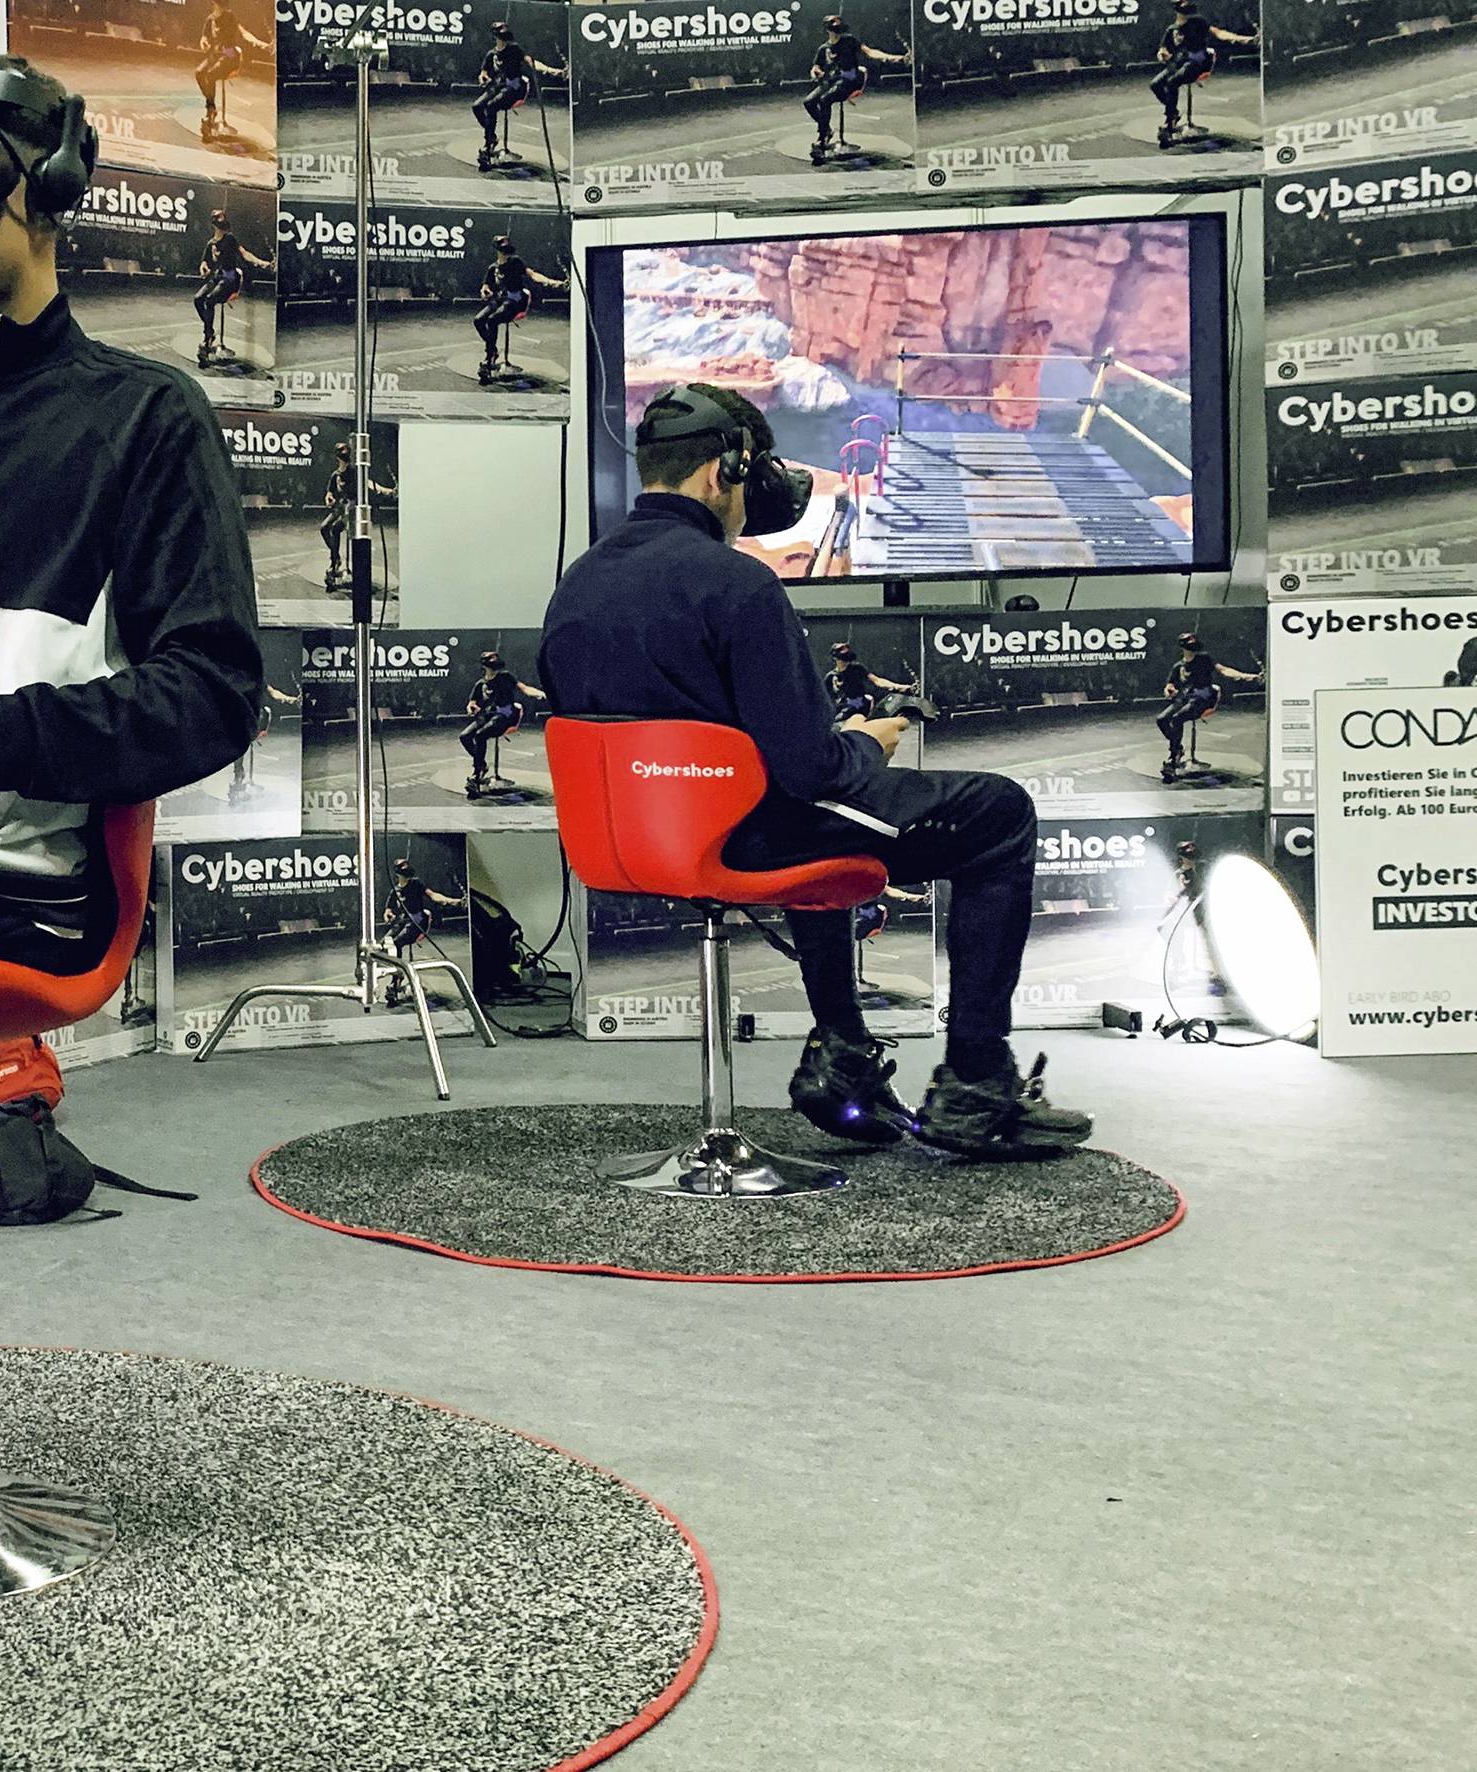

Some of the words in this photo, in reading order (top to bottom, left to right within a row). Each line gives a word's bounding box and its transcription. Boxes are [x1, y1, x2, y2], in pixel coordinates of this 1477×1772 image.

[581, 6, 791, 48] Cybershoes
[1276, 121, 1331, 145] STEP
[1337, 112, 1397, 137] INTO
[927, 148, 977, 167] STEP
[982, 145, 1035, 165] INTO
[1040, 143, 1069, 162] VR
[584, 164, 633, 184] STEP
[638, 162, 690, 181] INTO
[695, 160, 724, 179] VR
[1275, 166, 1477, 220] Cybersho
[1276, 338, 1332, 359] STEP
[1338, 332, 1398, 354] INTO
[1405, 329, 1439, 349] VR
[373, 372, 399, 391] VR
[1278, 385, 1477, 432] Cybersho
[1279, 552, 1335, 572] STEP
[1341, 549, 1400, 570] INTO
[1407, 547, 1441, 567] VR
[934, 621, 1147, 663] Cybershoes
[990, 655, 1014, 664] SHOES
[1016, 655, 1032, 664] FOR
[1033, 653, 1069, 664] WALKING
[1070, 653, 1080, 662] IN
[1081, 652, 1114, 662] VIRTUAL
[1115, 651, 1147, 660] REALITY
[632, 760, 734, 778] Cybershoes
[1343, 770, 1422, 782] Investieren
[1427, 768, 1448, 780] Sie
[1453, 767, 1466, 779] in
[1045, 777, 1074, 795] VR
[1343, 786, 1420, 802] profitieren
[1425, 785, 1446, 797] Sie
[1343, 804, 1391, 819] Erfolg.
[1396, 803, 1415, 815] Ab
[1421, 803, 1444, 815] 100
[255, 882, 269, 891] FOR
[270, 881, 301, 891] WALKING
[1377, 863, 1477, 893] Cybers
[1377, 901, 1477, 923] INVESTO
[285, 1004, 310, 1022] VR
[598, 996, 649, 1015] STEP
